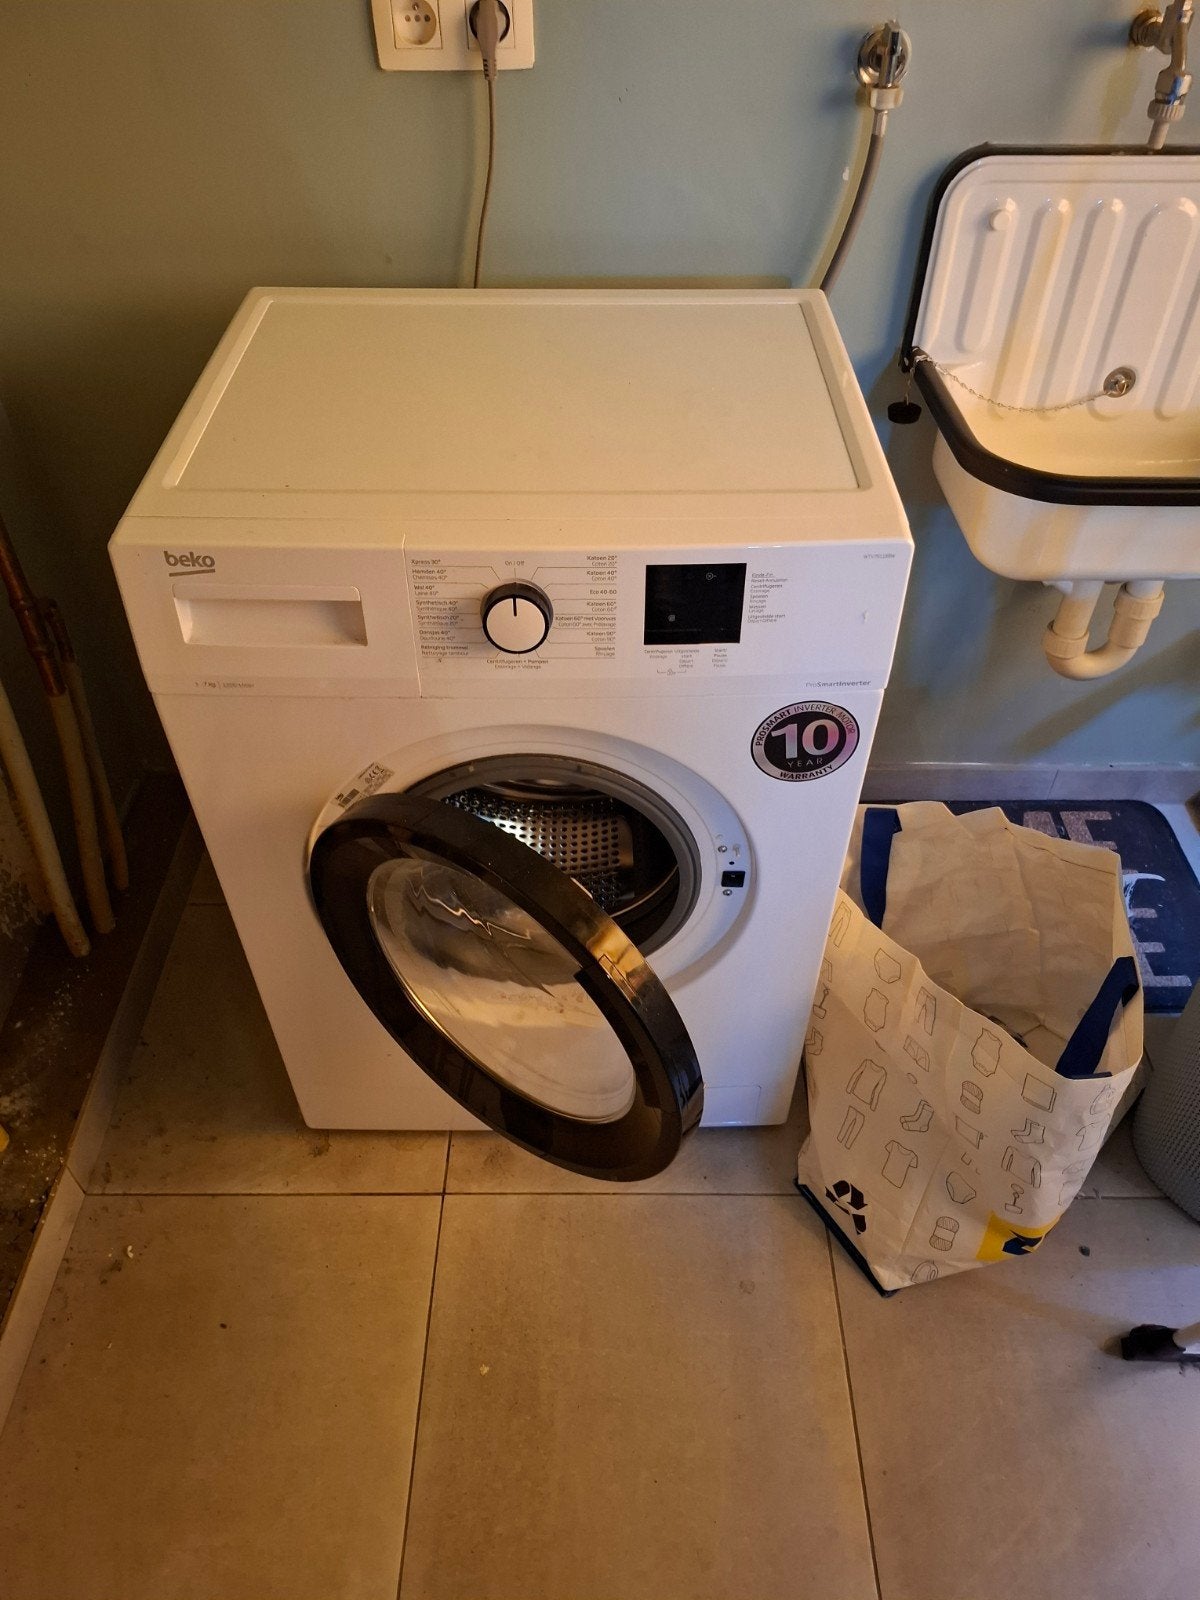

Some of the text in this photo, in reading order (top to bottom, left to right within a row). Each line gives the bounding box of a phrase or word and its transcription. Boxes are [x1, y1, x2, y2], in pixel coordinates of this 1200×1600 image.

[164, 551, 215, 567] beko
[806, 680, 872, 688] ProSmartInverter
[793, 703, 837, 715] INVERTER
[755, 709, 792, 746] PROSMART
[836, 711, 856, 735] MOTOR
[771, 719, 840, 759] 10
[787, 758, 823, 769] YEAR
[780, 764, 834, 780] WARRANTY
